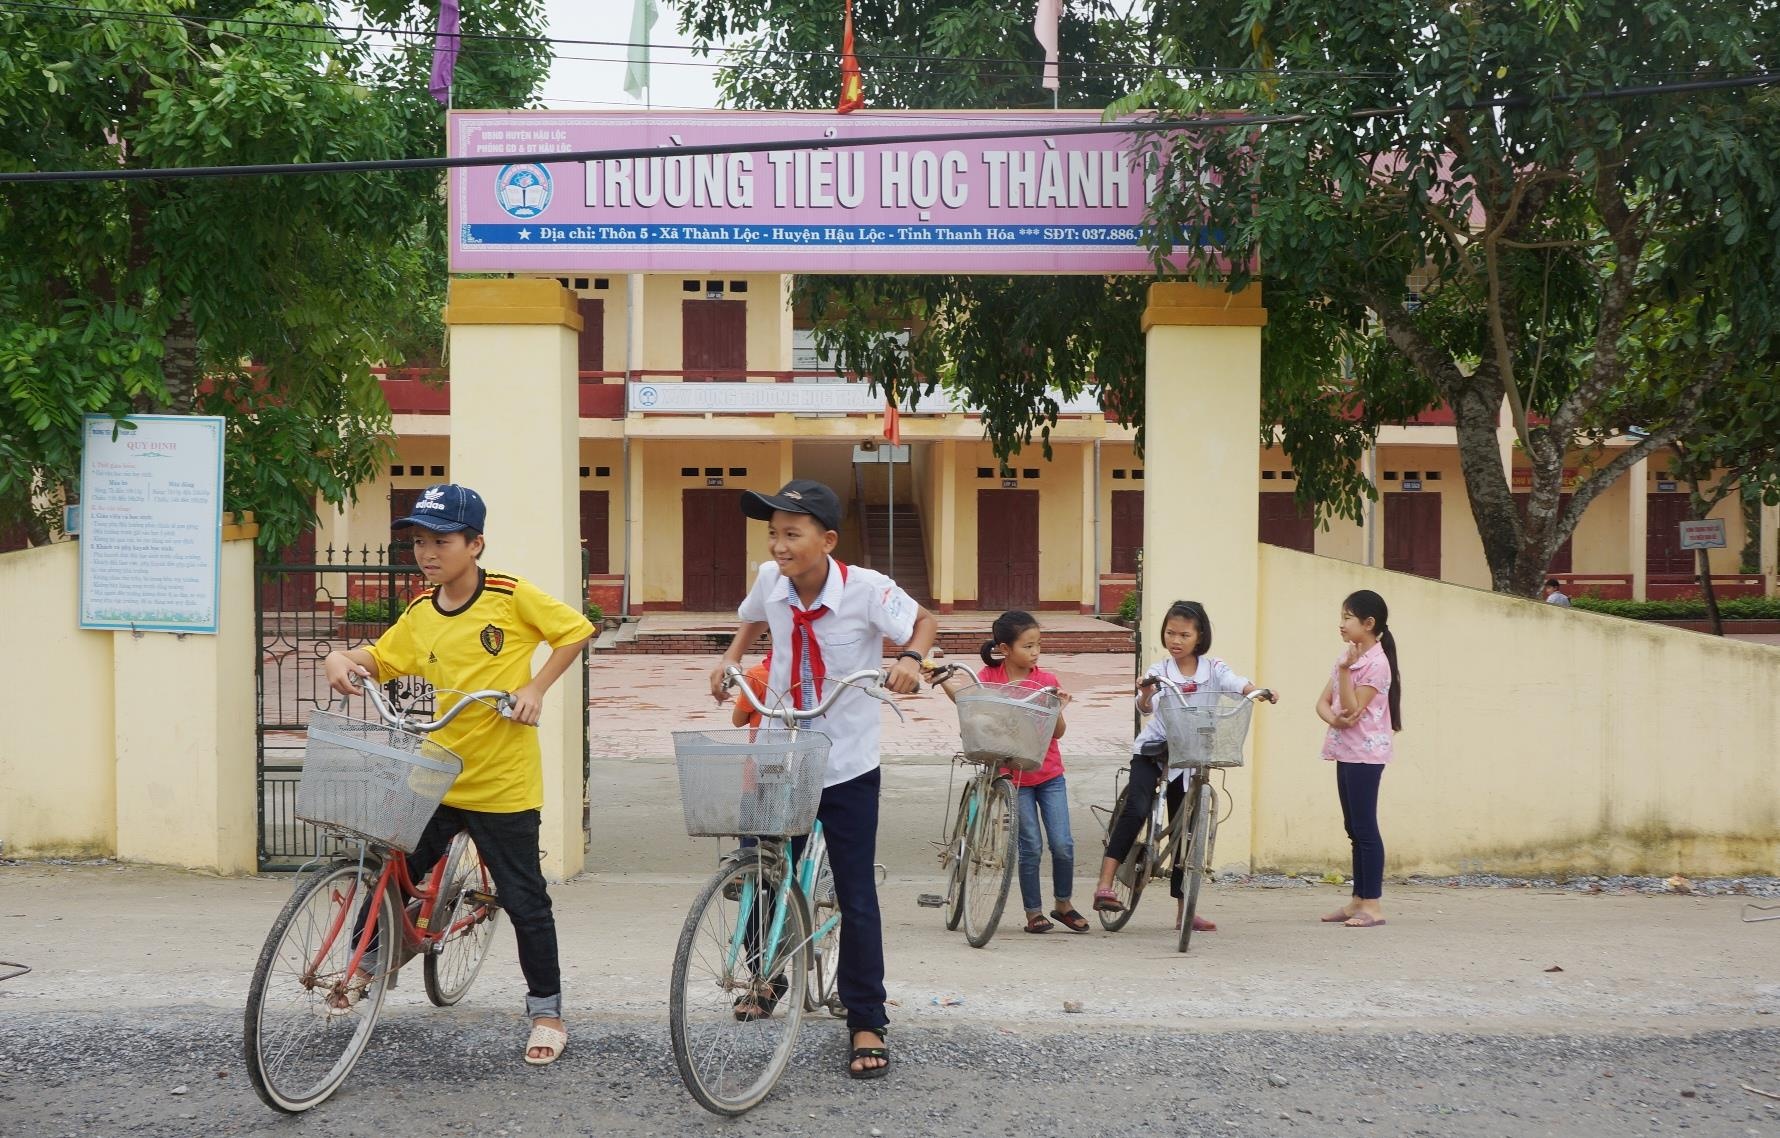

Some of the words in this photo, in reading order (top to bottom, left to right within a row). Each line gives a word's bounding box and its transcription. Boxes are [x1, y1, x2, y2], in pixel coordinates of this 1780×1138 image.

[481, 131, 504, 140] UBND
[578, 134, 754, 209] TRƯỜNG
[767, 126, 865, 209] TIỂU
[880, 150, 969, 222] HỌC
[982, 138, 1130, 209] THÀNH
[540, 227, 566, 242] Địa
[568, 226, 596, 240] chỉ:
[598, 226, 637, 240] Thôn
[639, 227, 649, 240] 5
[659, 227, 679, 240] Xã
[682, 227, 730, 240] Thành
[733, 227, 760, 243] Lộc
[772, 227, 821, 244] Huyện
[824, 227, 855, 244] Hậu
[858, 227, 886, 243] Lộc
[897, 226, 932, 240] Tỉnh
[935, 228, 983, 240] Thanh
[986, 227, 1016, 240] Hóa
[1043, 227, 1079, 240] SĐT:
[415, 499, 445, 510] adidas
